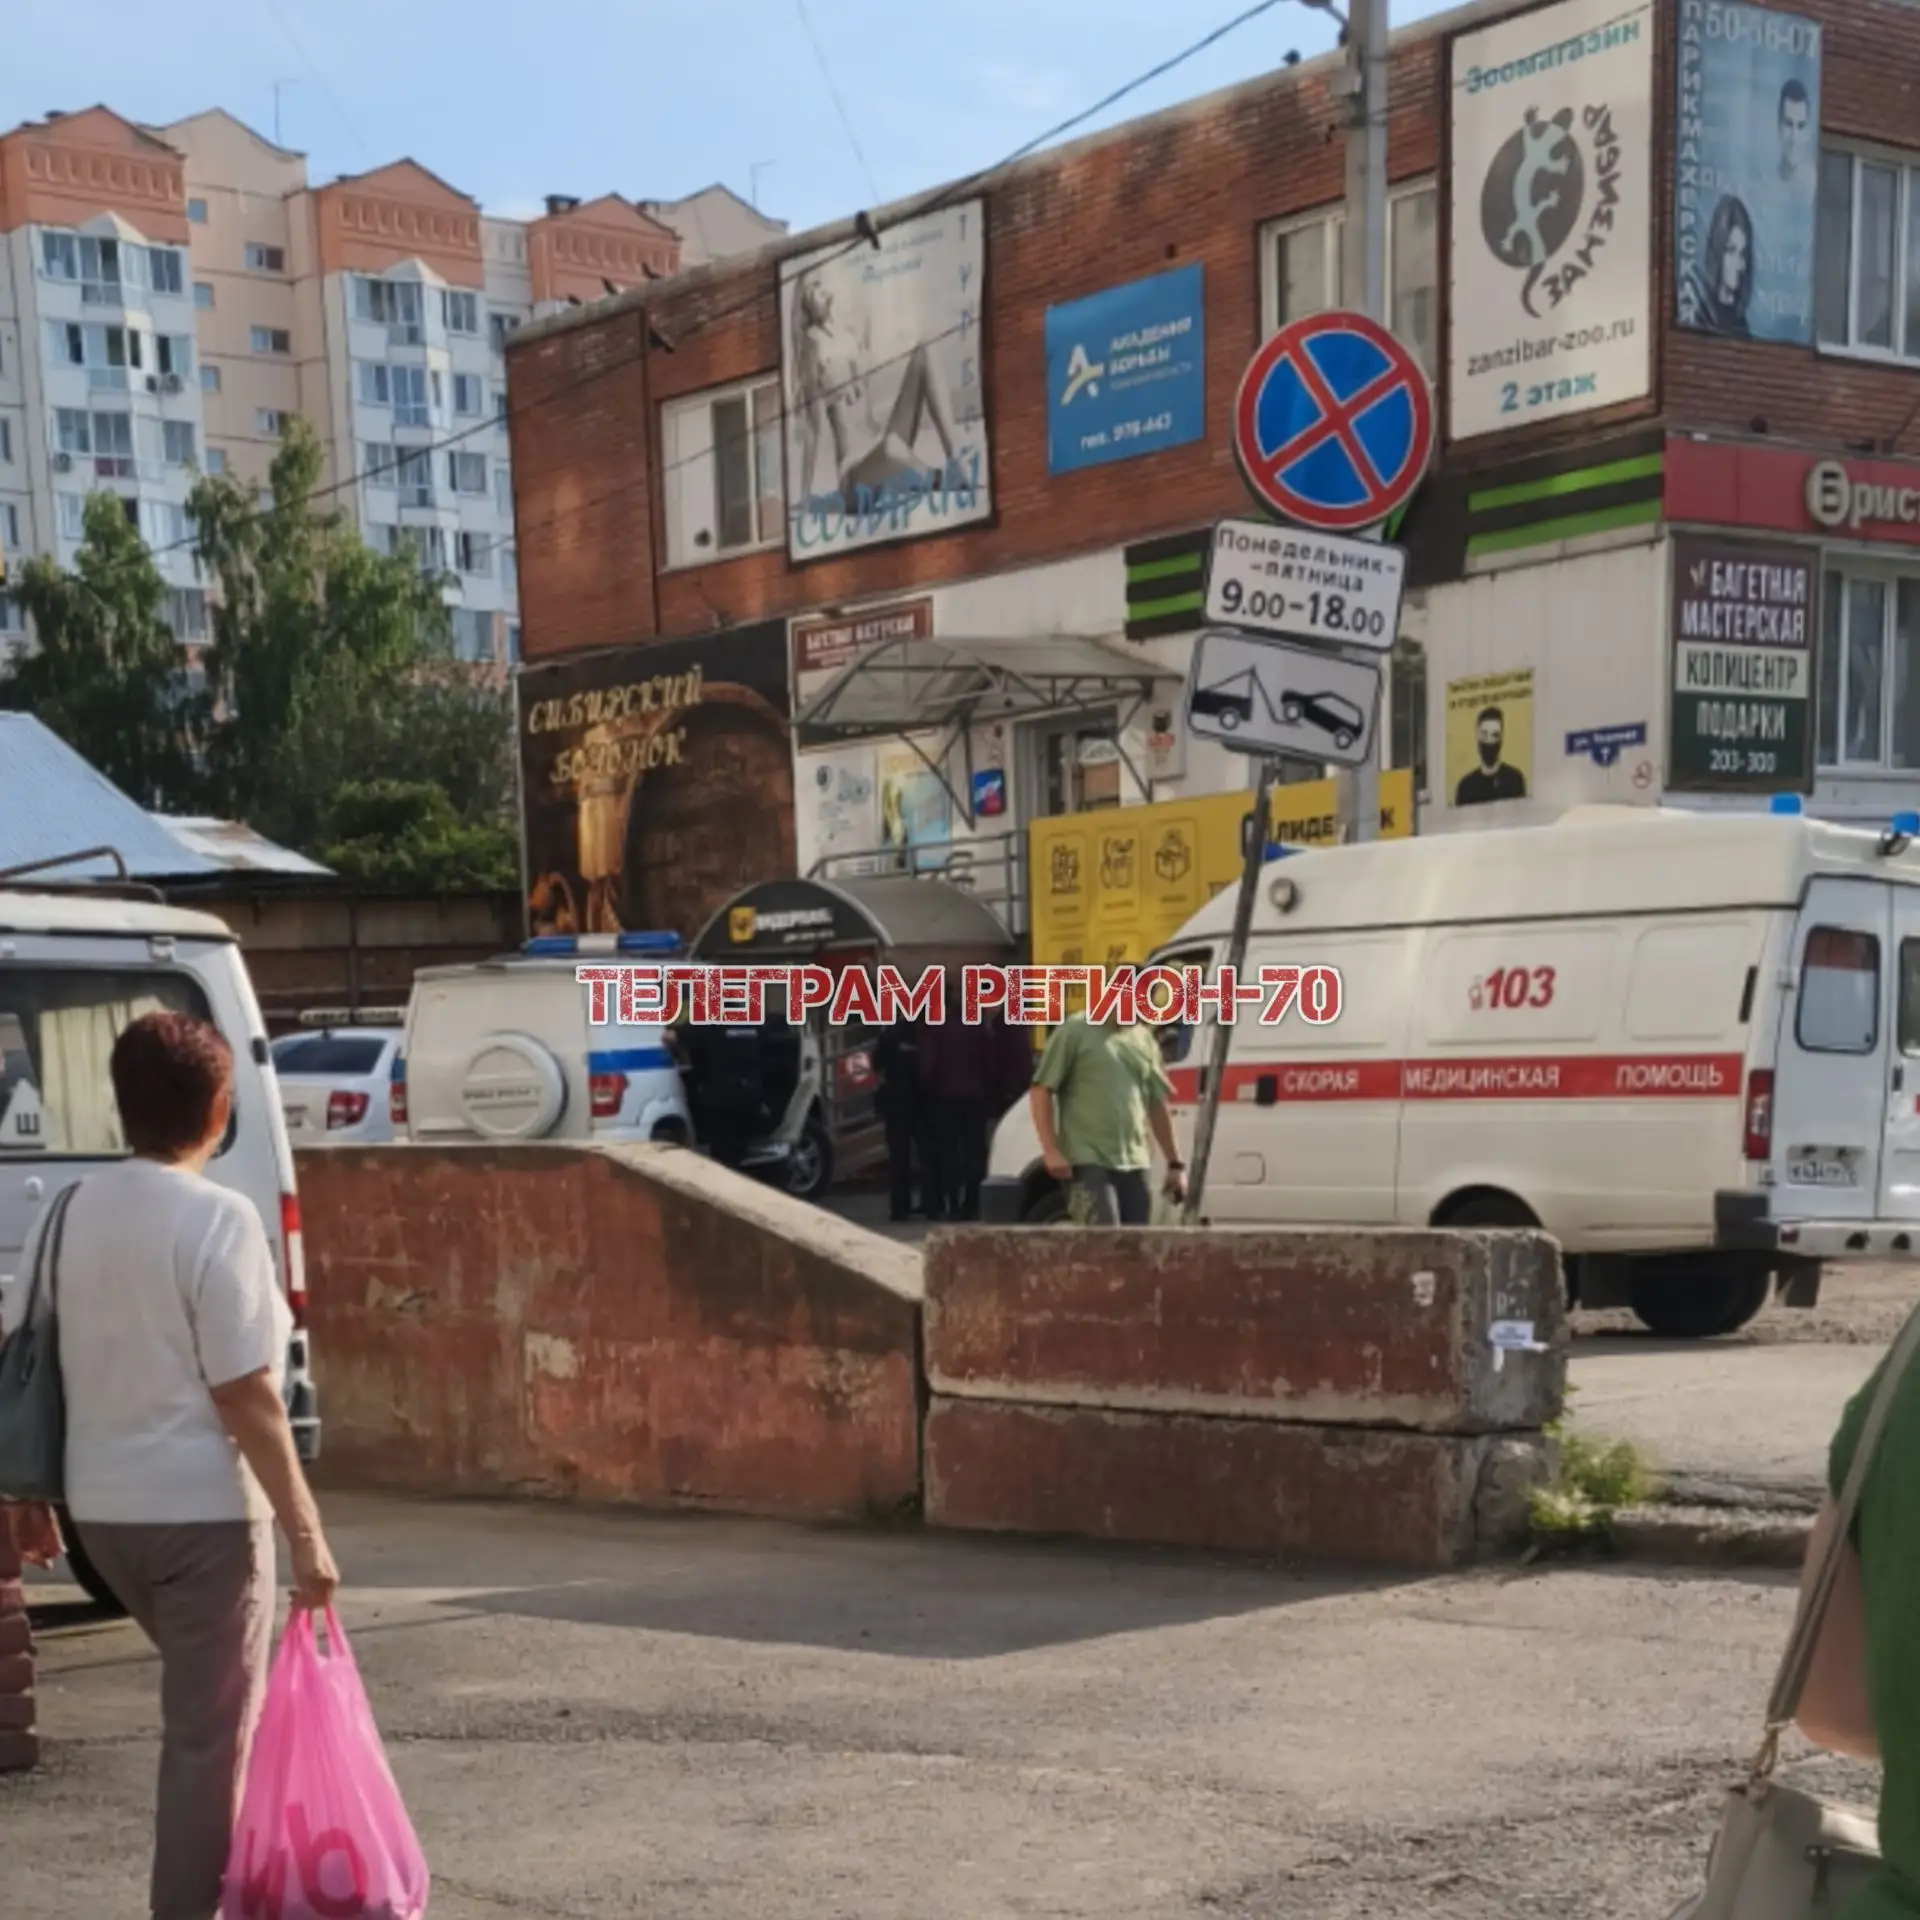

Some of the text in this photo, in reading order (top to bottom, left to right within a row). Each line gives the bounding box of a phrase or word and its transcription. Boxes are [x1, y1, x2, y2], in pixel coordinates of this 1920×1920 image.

[1465, 22, 1641, 95] Зоомагазин
[1467, 316, 1635, 376] zanzibar-zoo.ru
[1501, 371, 1598, 412] 2 этаж
[1806, 460, 1920, 530] Брис
[1711, 561, 1807, 605] БАГЕТНАЯ
[1221, 578, 1386, 637] 9.00-18.00
[1682, 600, 1805, 643] МАСТЕРСКАЯ
[1686, 651, 1799, 691] КОПИЦЕНТР
[1696, 702, 1786, 742] ПОДАРКИ
[1709, 749, 1777, 774] 203-300
[1484, 966, 1556, 1009] 103
[1284, 1062, 1724, 1092] СКОРАЯ МЕДИЦИНСКАЯ ПОМОЩЬ
[16, 1112, 40, 1136] Ш
